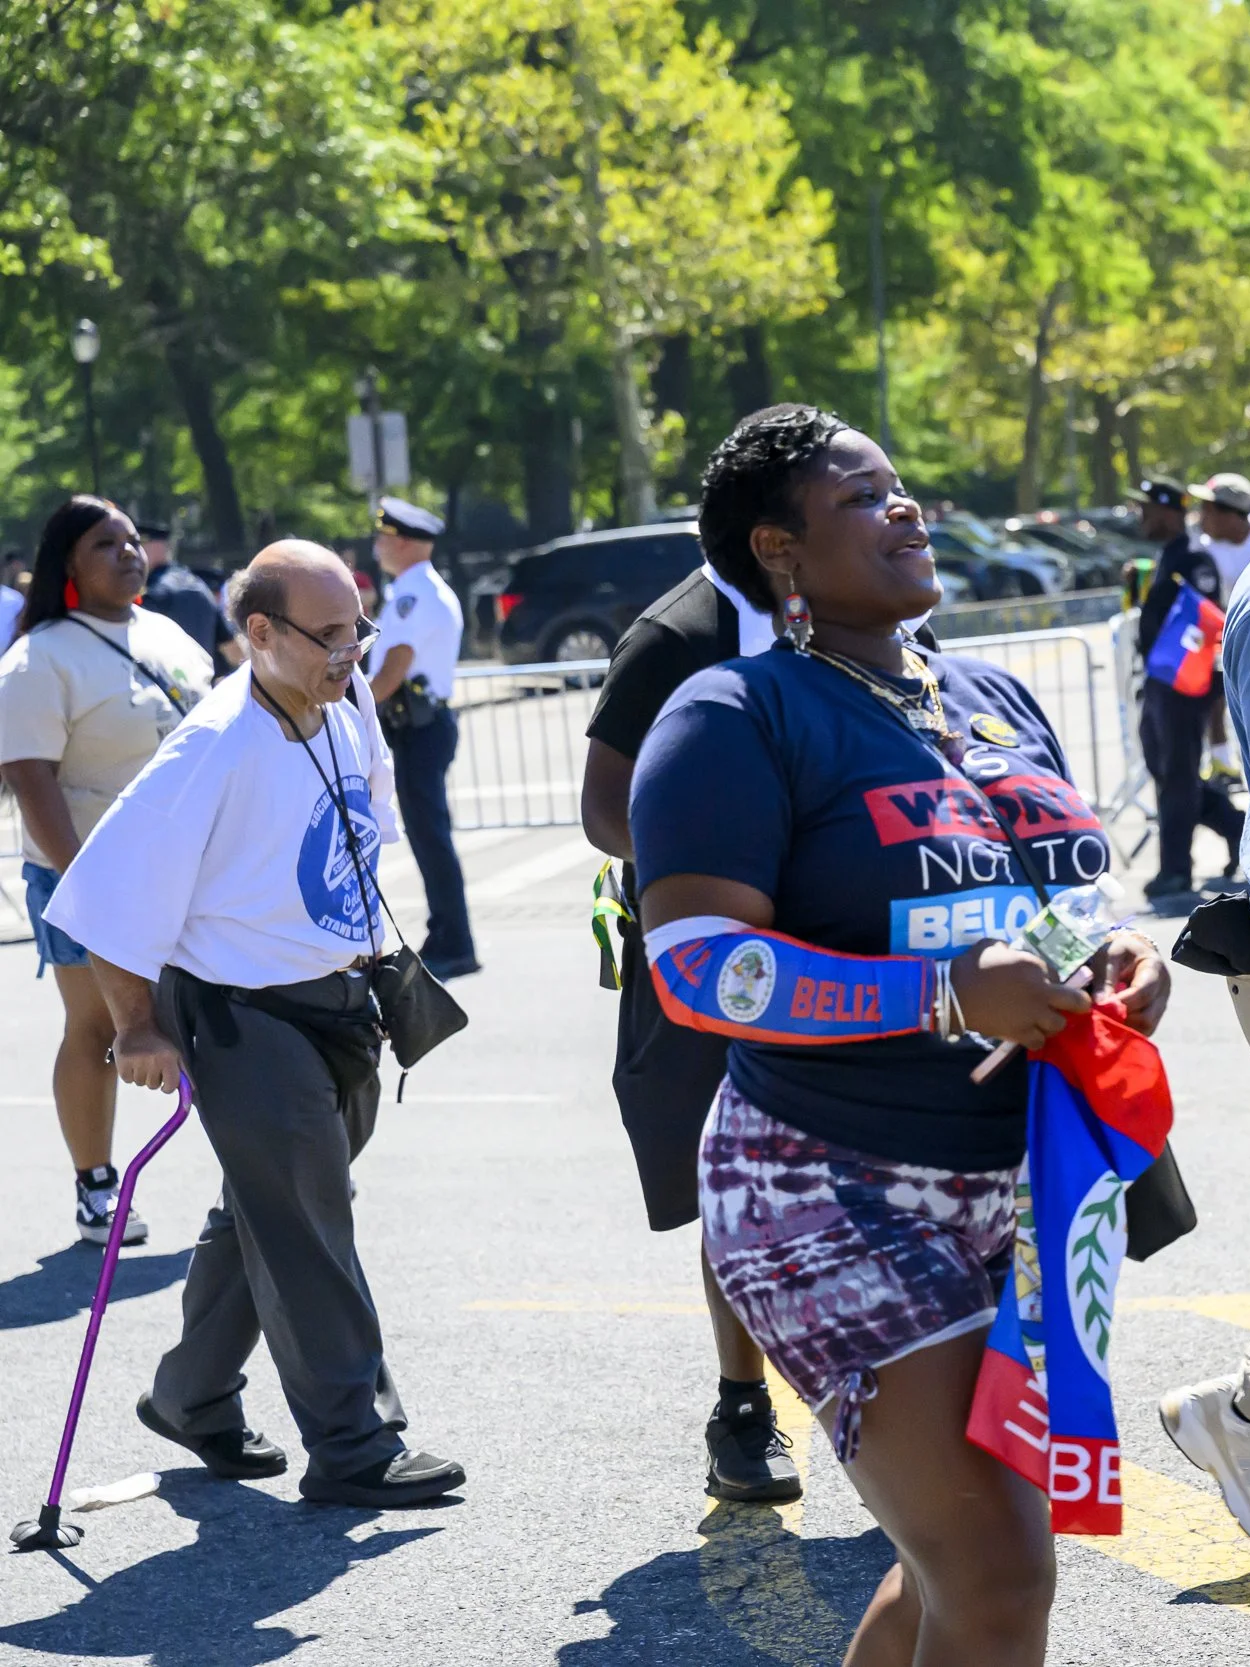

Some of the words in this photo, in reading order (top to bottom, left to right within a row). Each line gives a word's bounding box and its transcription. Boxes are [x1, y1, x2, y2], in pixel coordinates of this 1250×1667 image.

[888, 785, 1092, 828] WRONG
[918, 841, 1014, 889] NOT
[1032, 835, 1107, 880] TO
[908, 894, 1041, 949] BELO
